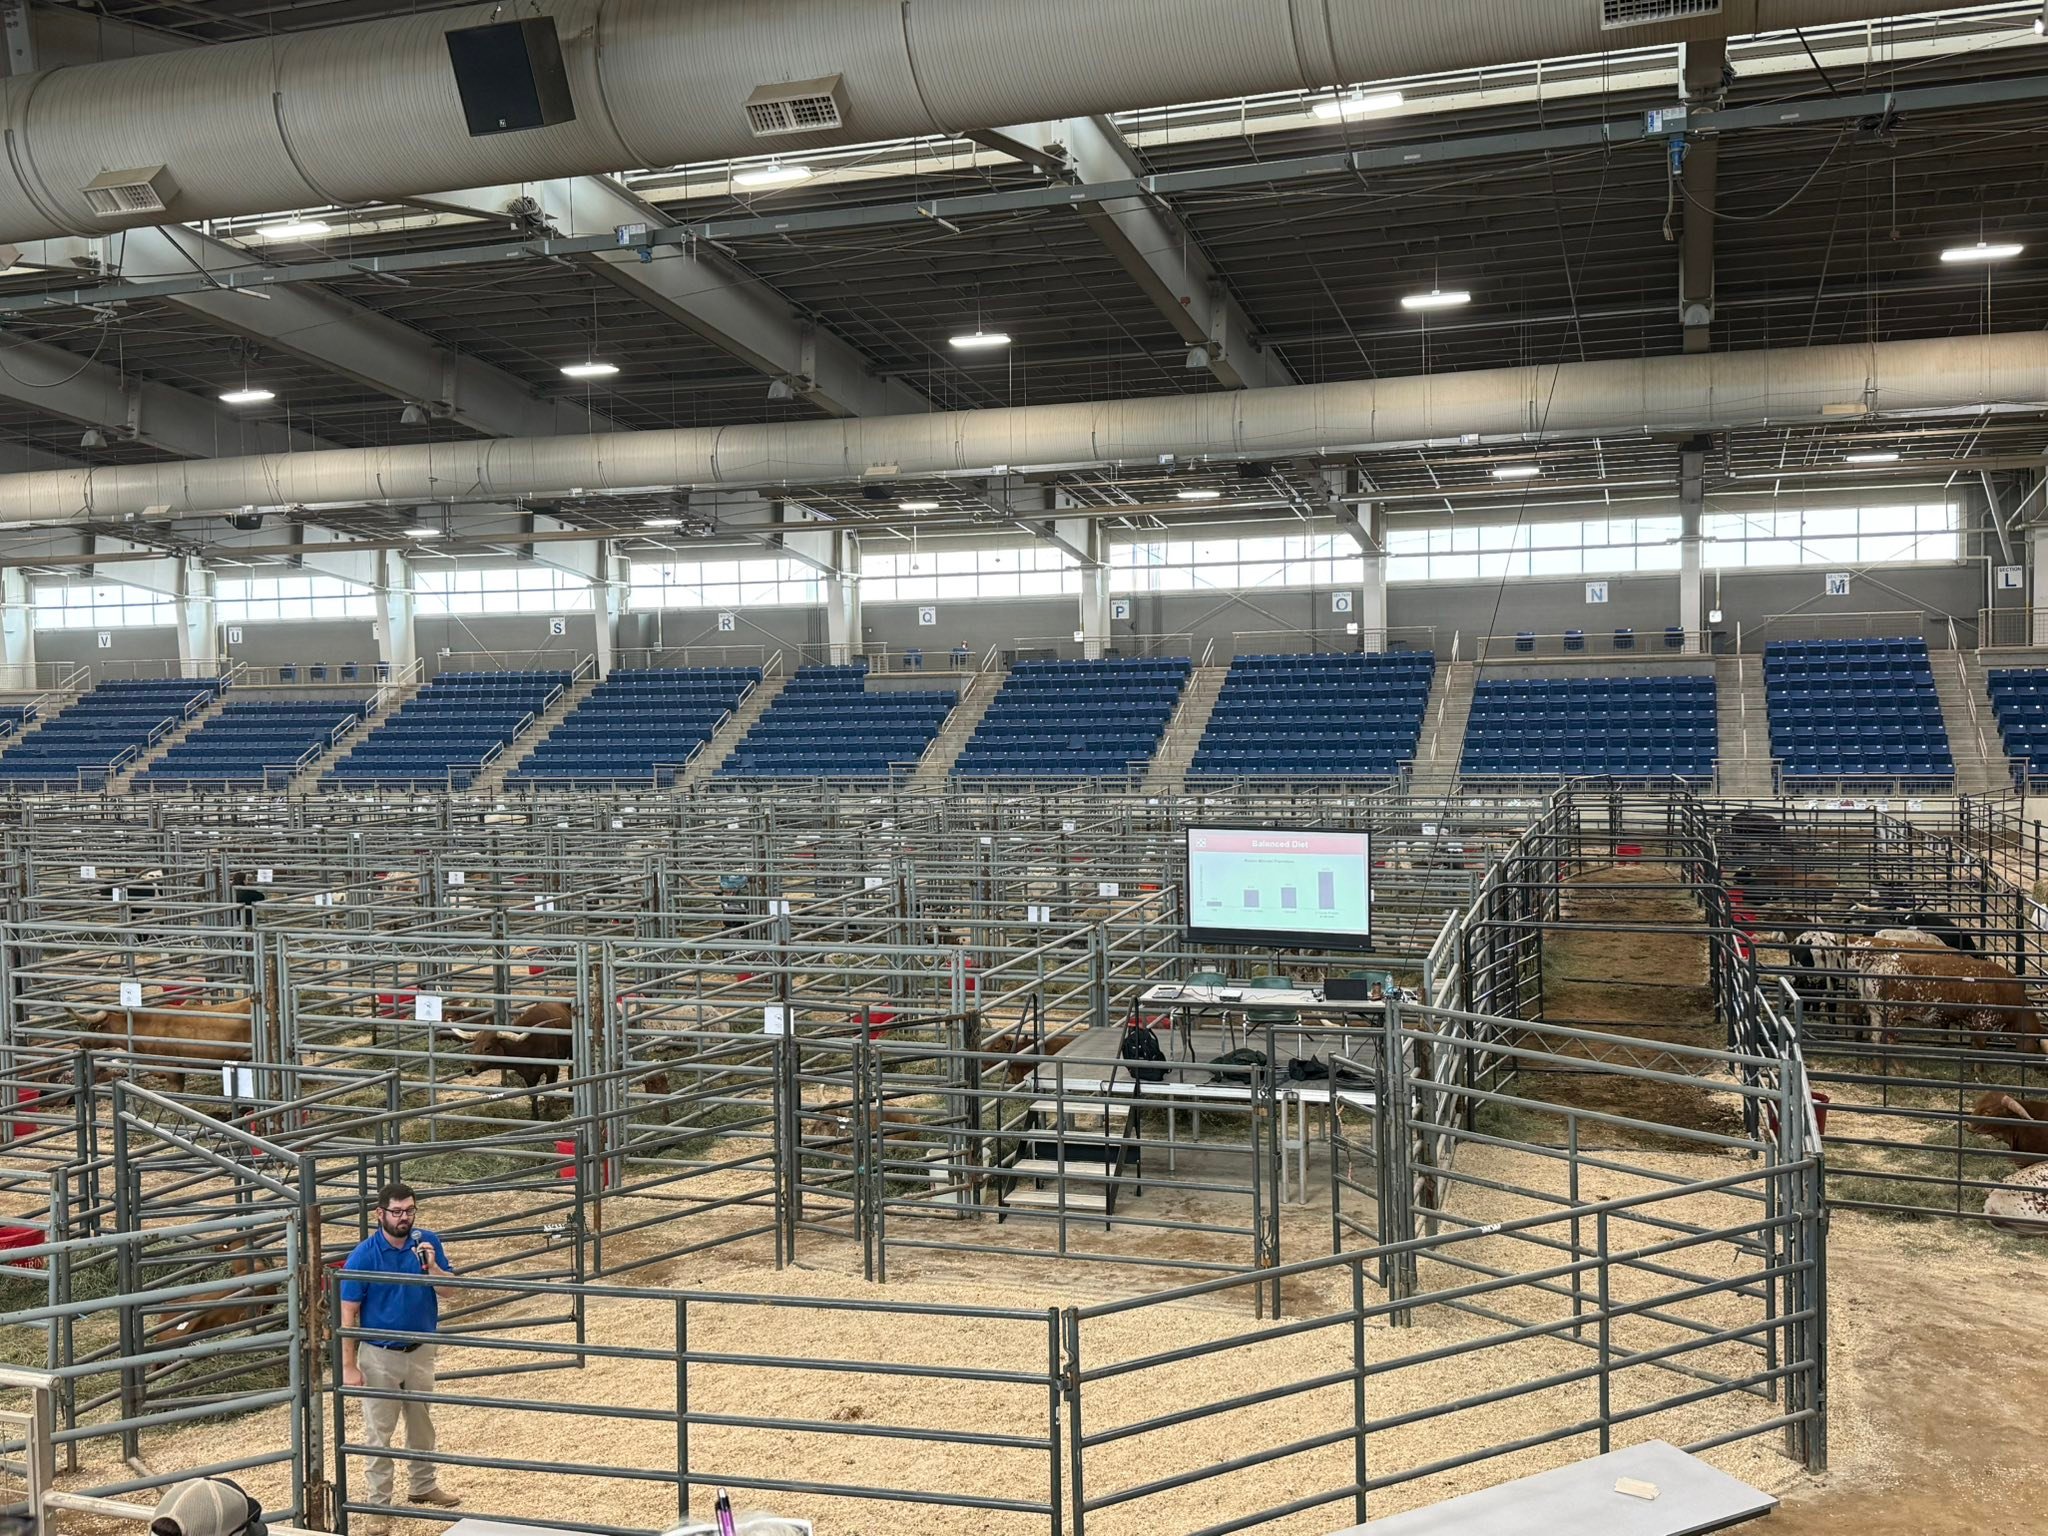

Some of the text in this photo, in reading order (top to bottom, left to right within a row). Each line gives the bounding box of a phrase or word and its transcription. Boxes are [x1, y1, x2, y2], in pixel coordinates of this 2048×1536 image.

[1831, 579, 1845, 593] M
[2005, 573, 2017, 587] L
[1591, 588, 1603, 601] N
[1336, 597, 1349, 610] O
[922, 612, 933, 623] Q
[1116, 606, 1125, 618] P
[553, 622, 562, 634] S
[722, 618, 731, 630] R
[100, 636, 109, 647] V
[231, 631, 240, 643] U
[1251, 840, 1309, 849] Balanced Diet
